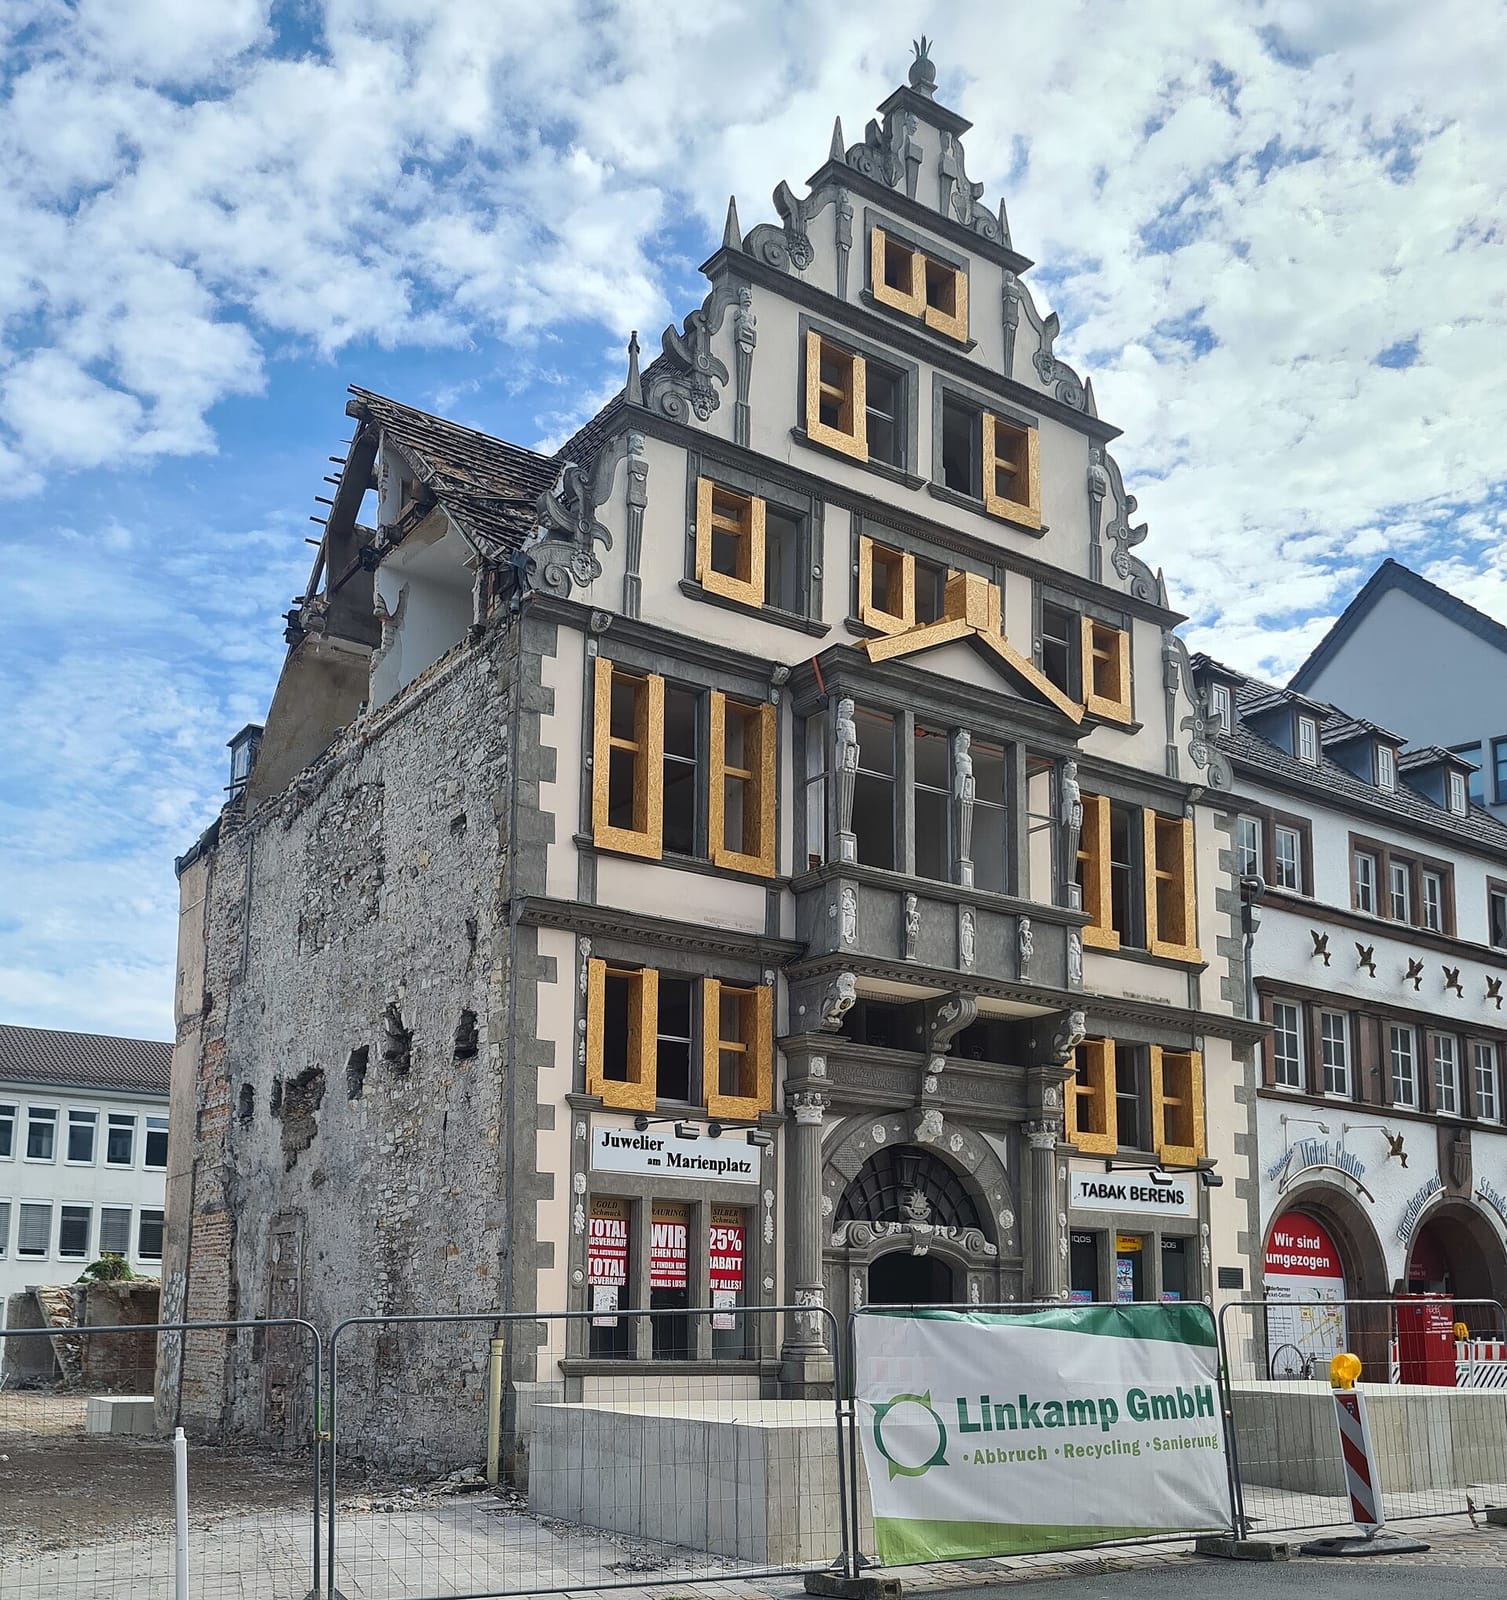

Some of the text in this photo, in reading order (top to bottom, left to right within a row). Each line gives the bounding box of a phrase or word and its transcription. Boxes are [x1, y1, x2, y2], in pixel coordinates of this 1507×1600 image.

[601, 1131, 664, 1151] Juwelier
[647, 1152, 752, 1175] am Marienplatz
[1081, 1182, 1185, 1204] TABAK BERENS
[1479, 1176, 1507, 1219] Stande
[591, 1208, 621, 1217] Schmuck
[596, 1200, 618, 1209] GOLD
[713, 1208, 738, 1217] SILBER
[711, 1215, 739, 1224] Schmuck
[588, 1237, 627, 1247] USVERKAUF
[651, 1224, 686, 1248] WIR
[710, 1228, 742, 1251] 25%
[1160, 1240, 1177, 1249] QOS
[1274, 1232, 1320, 1249] Wir sind
[651, 1248, 671, 1258] IEHEN
[1265, 1253, 1330, 1270] umgezogen
[588, 1276, 626, 1286] USVERKAUF
[710, 1279, 742, 1290] UF ALLES!
[956, 1384, 1215, 1433] Linkamp GmbH
[973, 1432, 1219, 1465] Abbruch Recycling Sanierung
